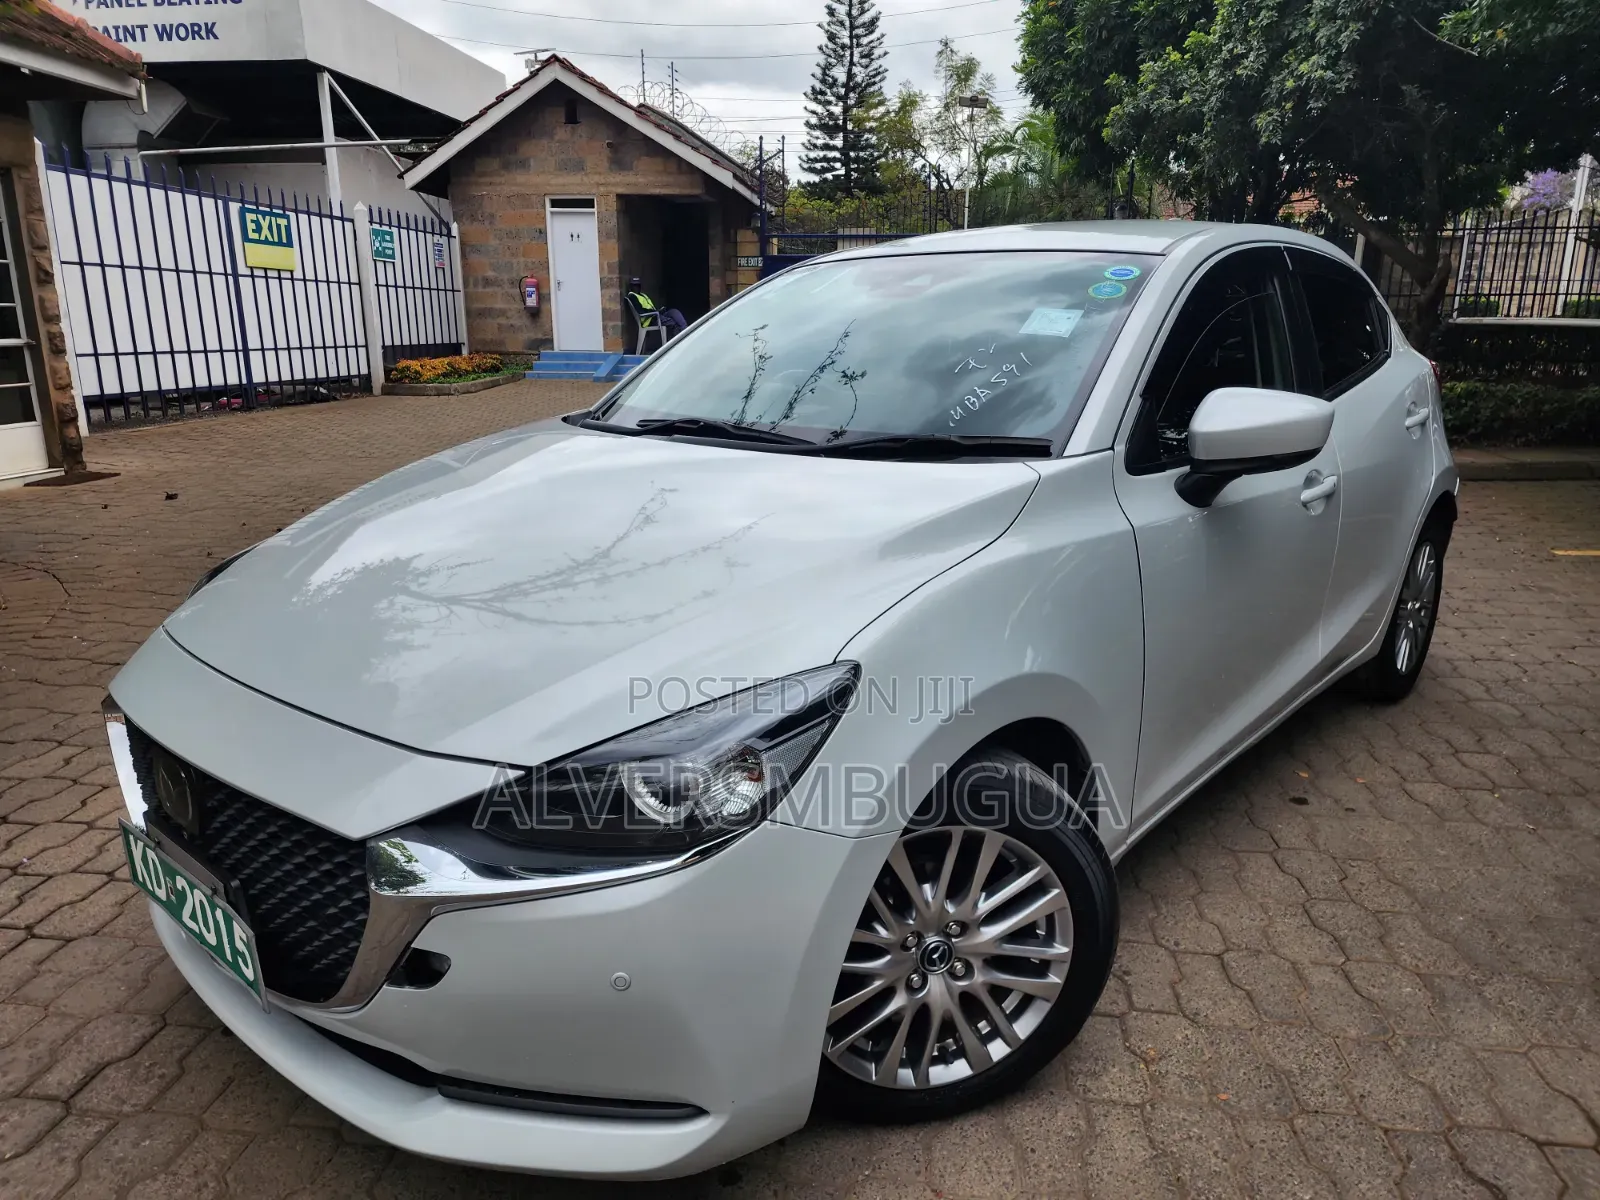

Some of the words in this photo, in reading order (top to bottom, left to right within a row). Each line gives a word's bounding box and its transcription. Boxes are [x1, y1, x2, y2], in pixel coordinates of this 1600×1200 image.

[91, 24, 149, 42] AINT
[153, 22, 219, 42] WORK
[245, 212, 288, 244] EXIT
[737, 257, 748, 267] FIRE
[748, 257, 758, 267] EXIT
[175, 875, 255, 982] 2015
